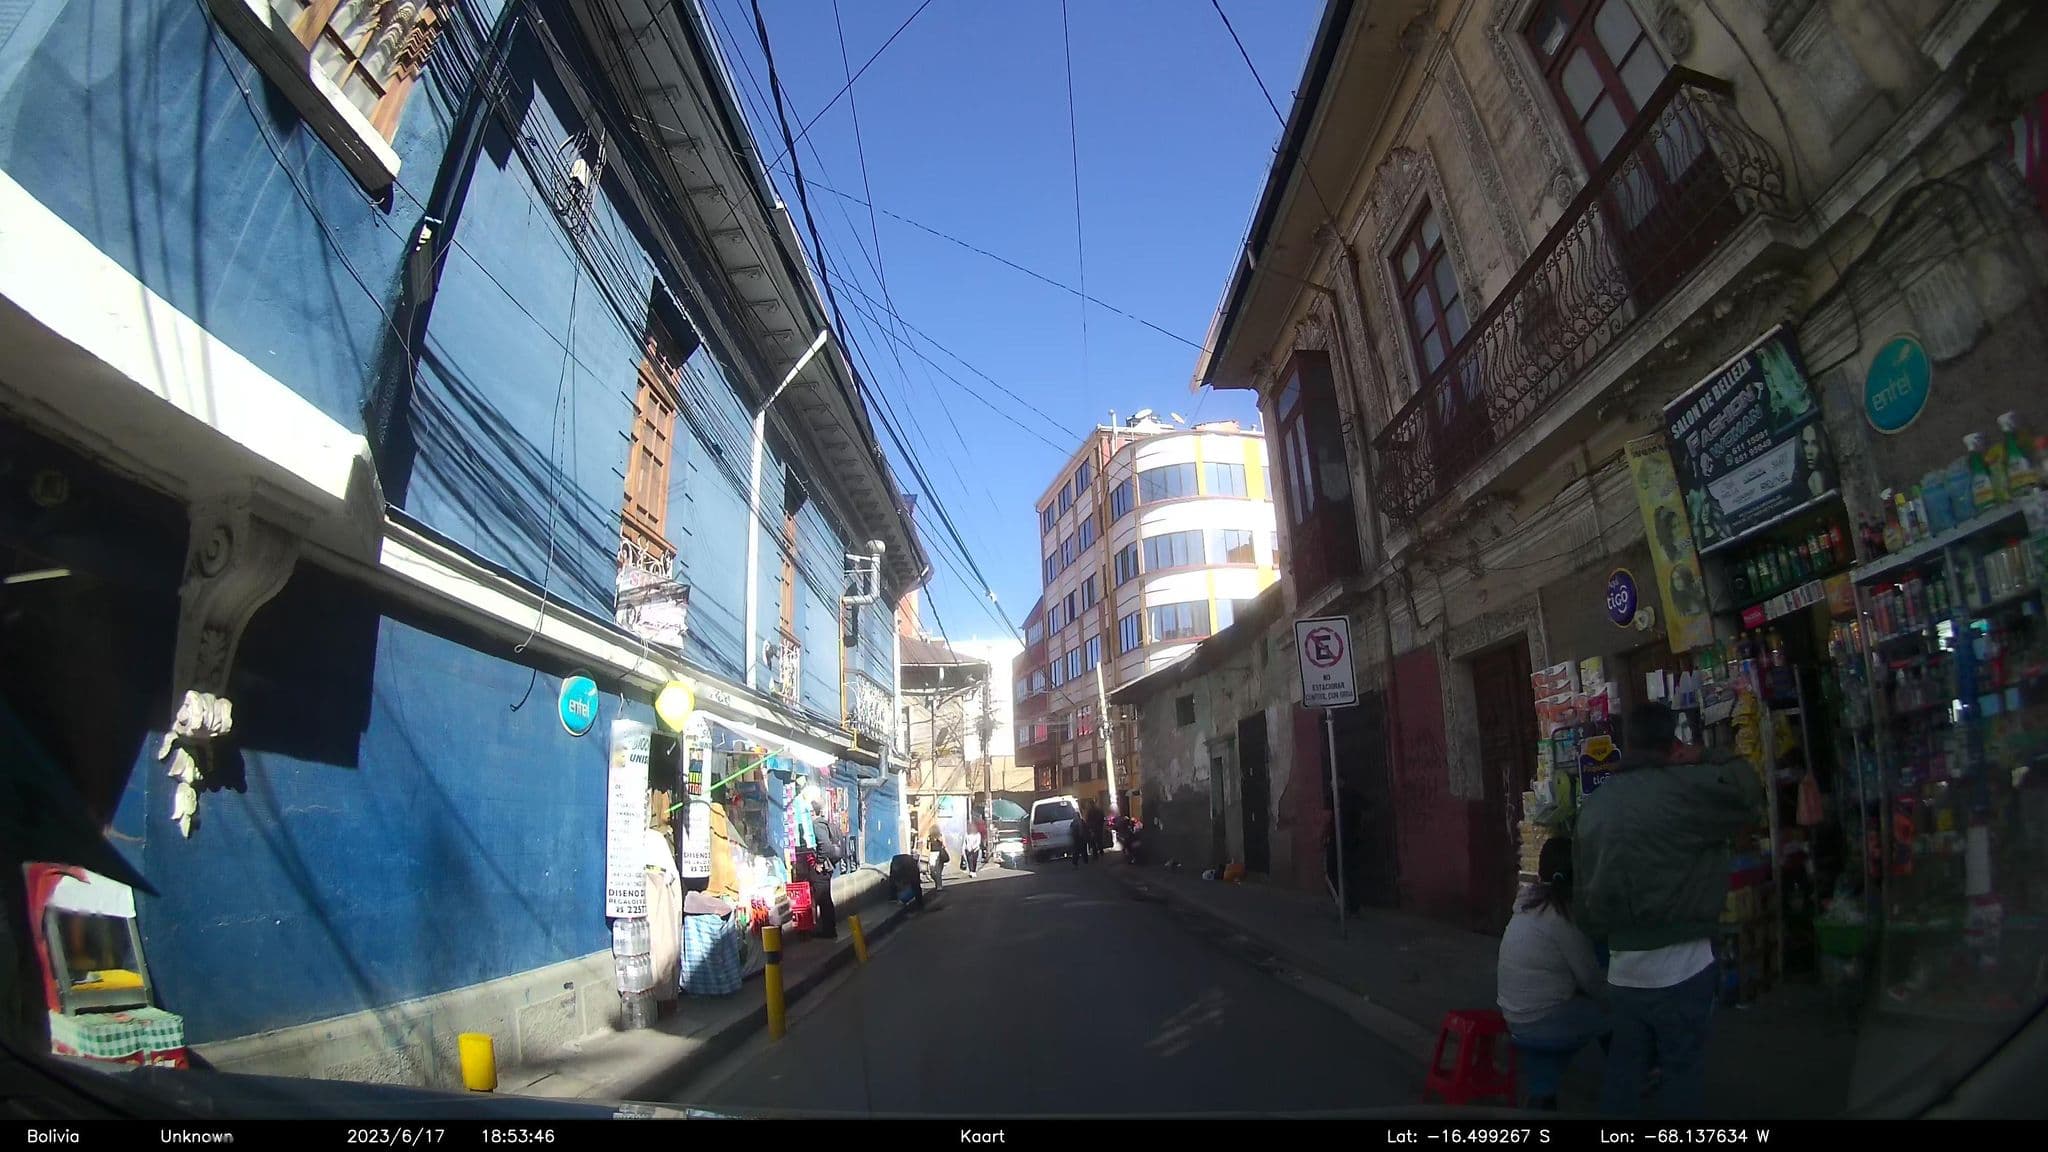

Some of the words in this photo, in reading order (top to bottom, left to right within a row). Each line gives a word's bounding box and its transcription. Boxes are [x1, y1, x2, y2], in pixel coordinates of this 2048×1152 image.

[1670, 403, 1702, 440] SALON
[1698, 391, 1715, 414] DE
[1711, 357, 1752, 402] BELLEZA
[1871, 368, 1912, 412] entel
[1685, 383, 1756, 458] FASHION
[568, 698, 590, 719] entel
